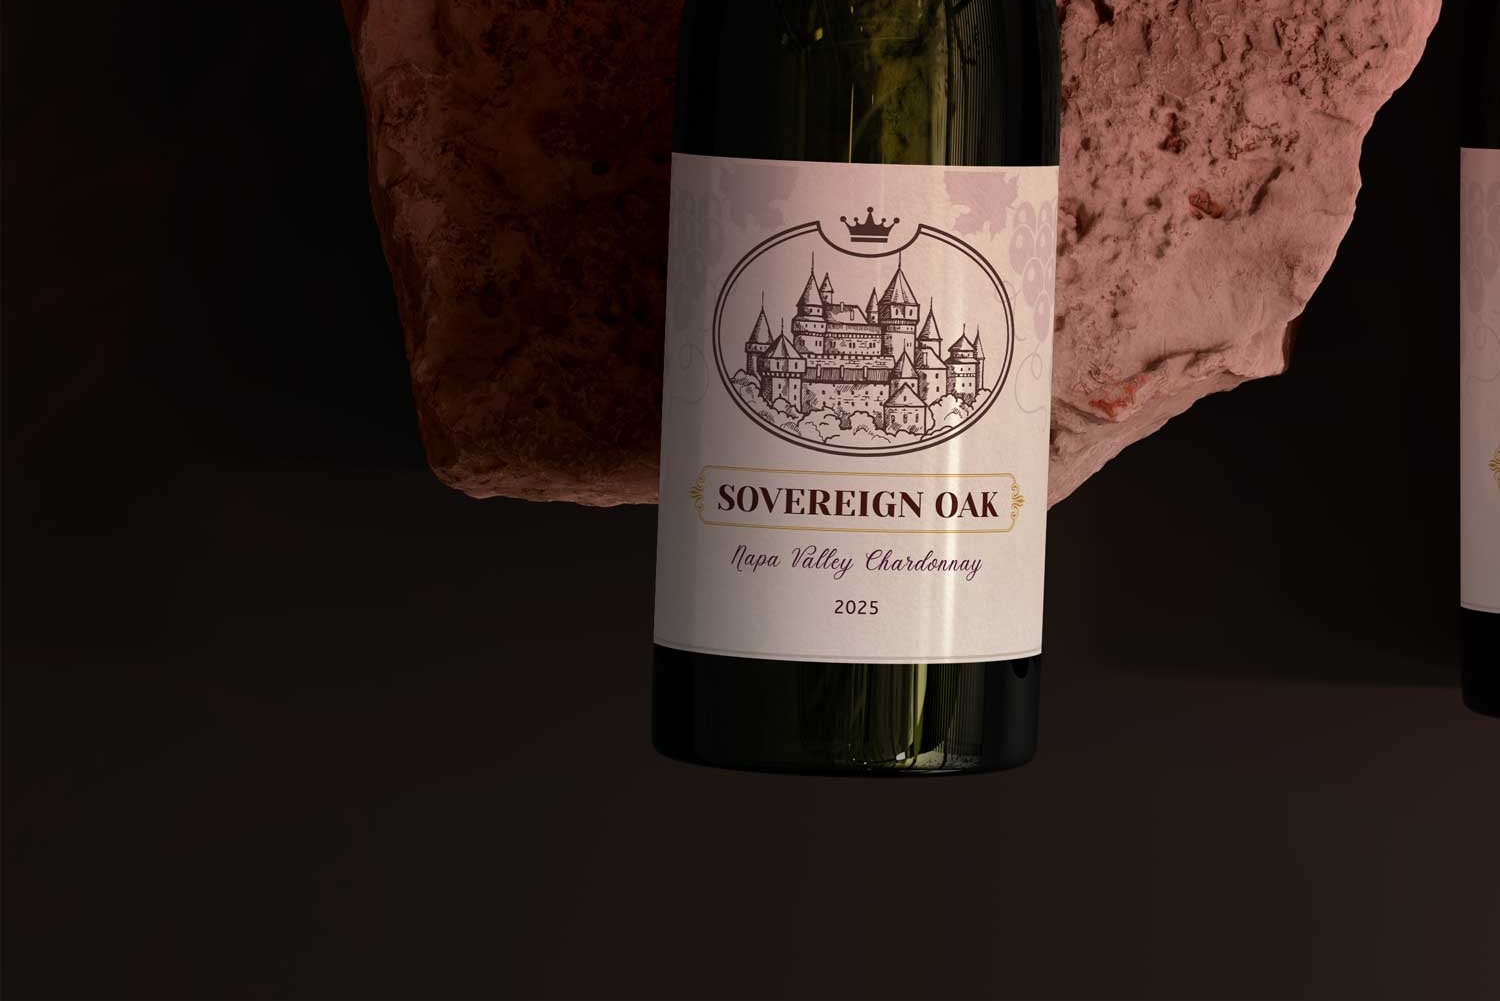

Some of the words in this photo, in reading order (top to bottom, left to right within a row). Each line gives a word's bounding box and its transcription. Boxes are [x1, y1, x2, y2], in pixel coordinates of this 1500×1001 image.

[717, 483, 923, 518] SOVEREIGN
[935, 491, 999, 518] OAK
[731, 544, 781, 577] Napa
[791, 545, 853, 580] Valley
[865, 549, 983, 581] Chardonnay
[834, 599, 879, 615] 2025
